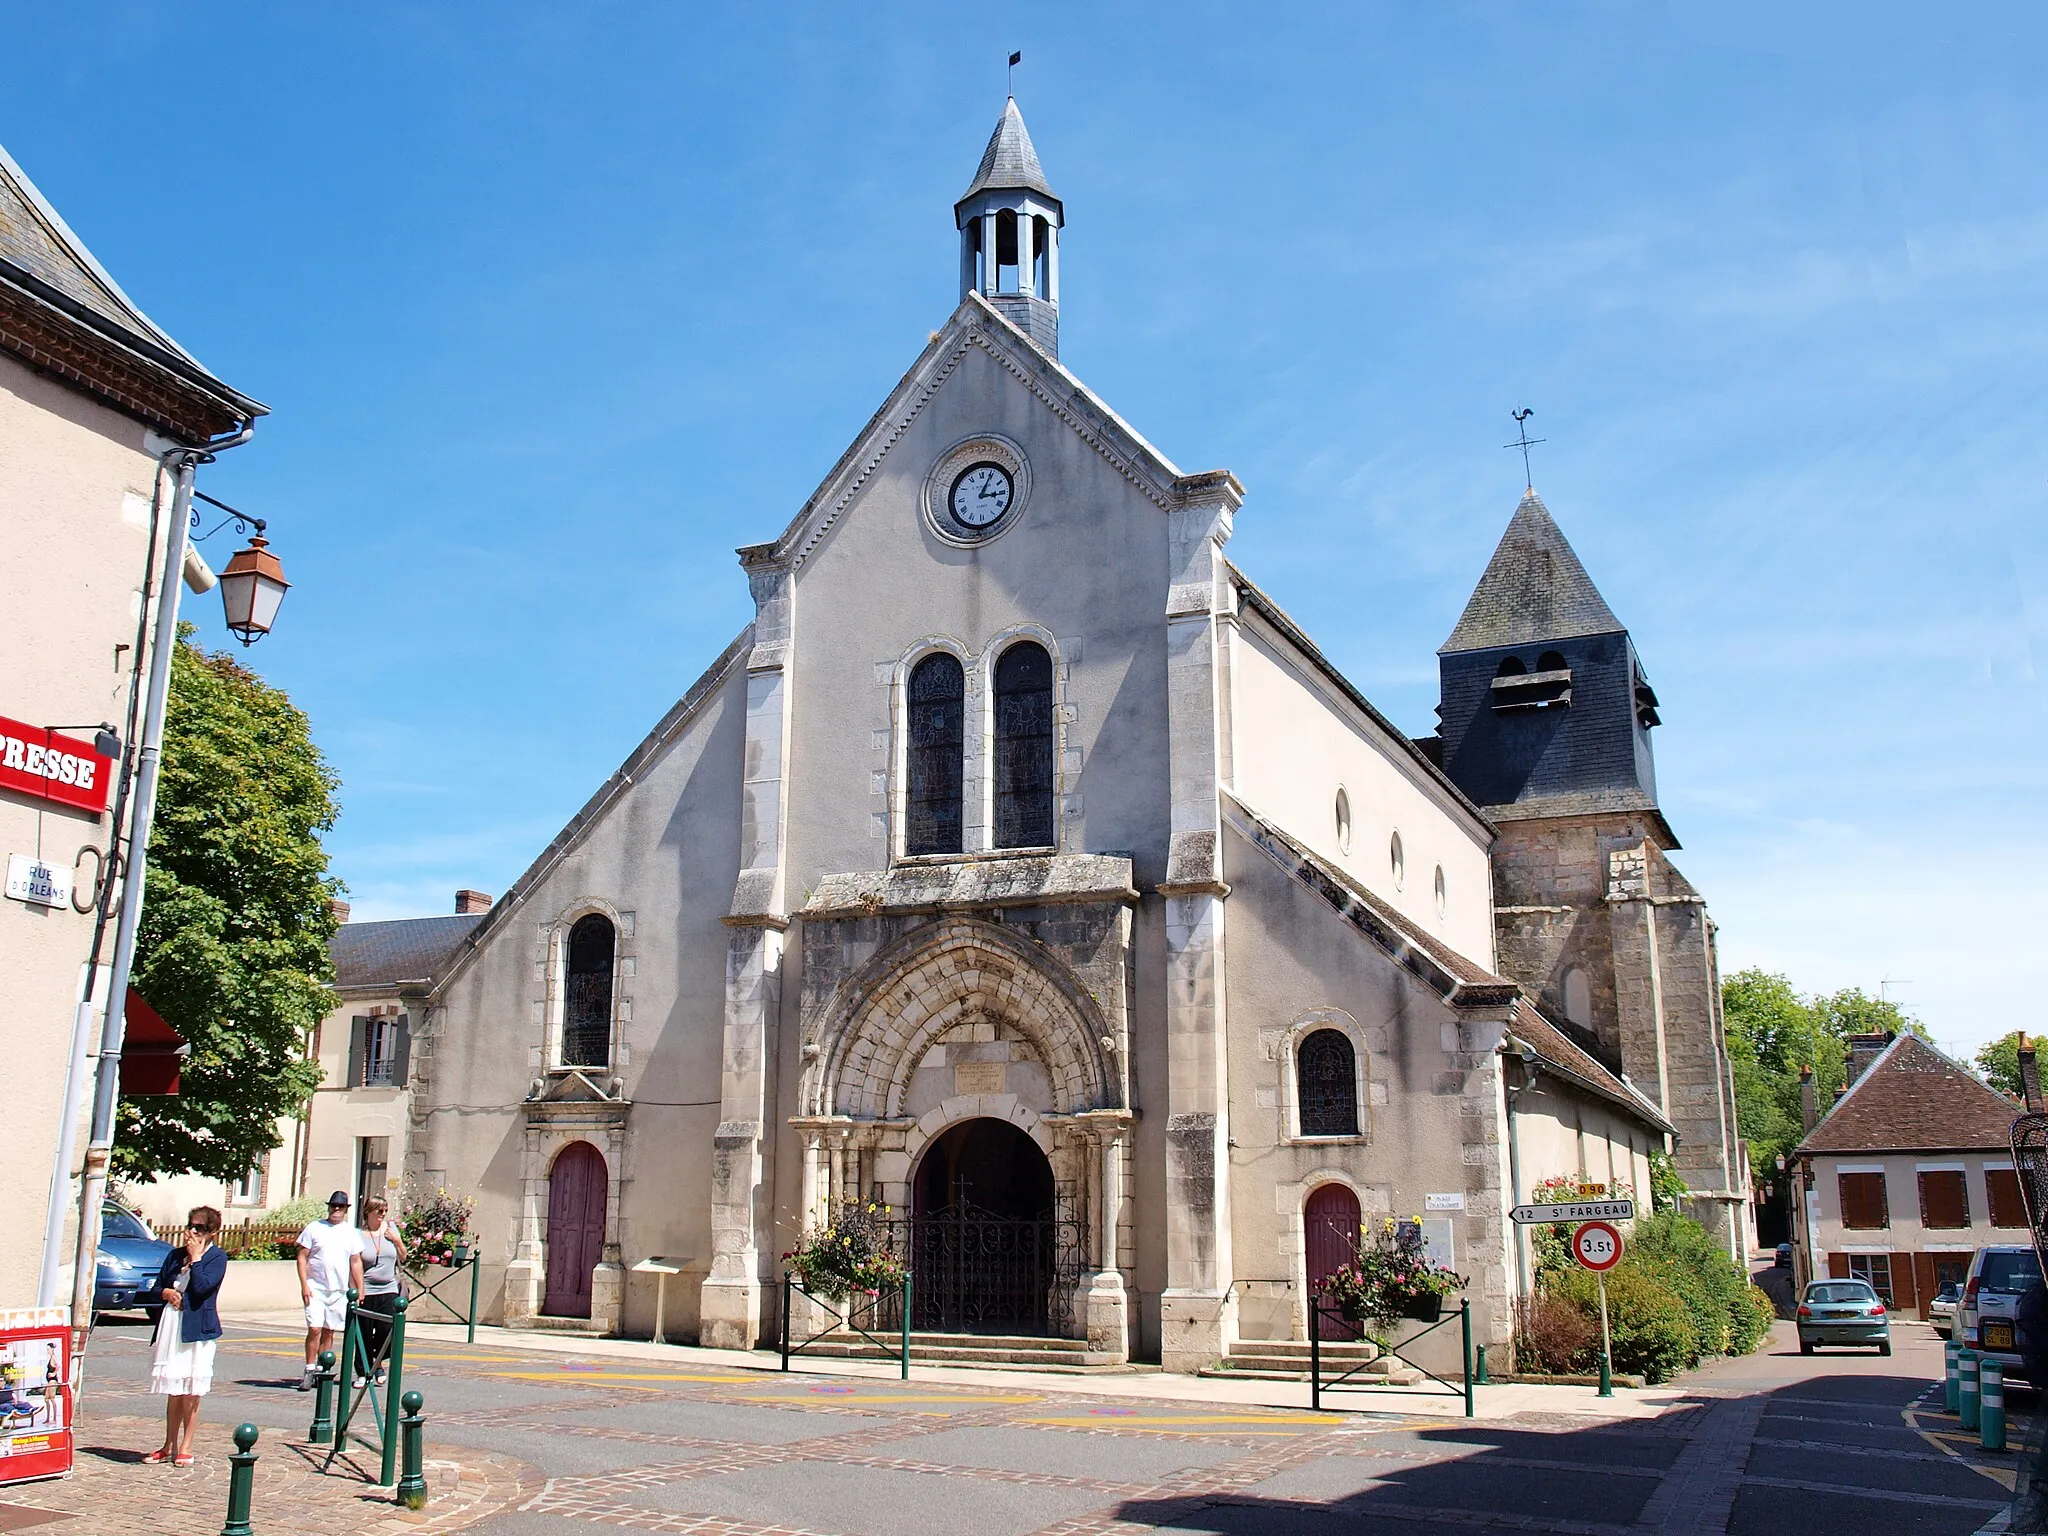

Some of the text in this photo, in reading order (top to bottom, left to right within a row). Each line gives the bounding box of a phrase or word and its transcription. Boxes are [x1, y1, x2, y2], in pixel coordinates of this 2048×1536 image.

[30, 866, 53, 881] RUE
[12, 881, 65, 900] DORLÉANS
[1580, 1185, 1605, 1195] D 90
[1520, 1210, 1534, 1219] 12
[1570, 1204, 1629, 1217] FARGEAU
[1583, 1239, 1612, 1253] 3.5t
